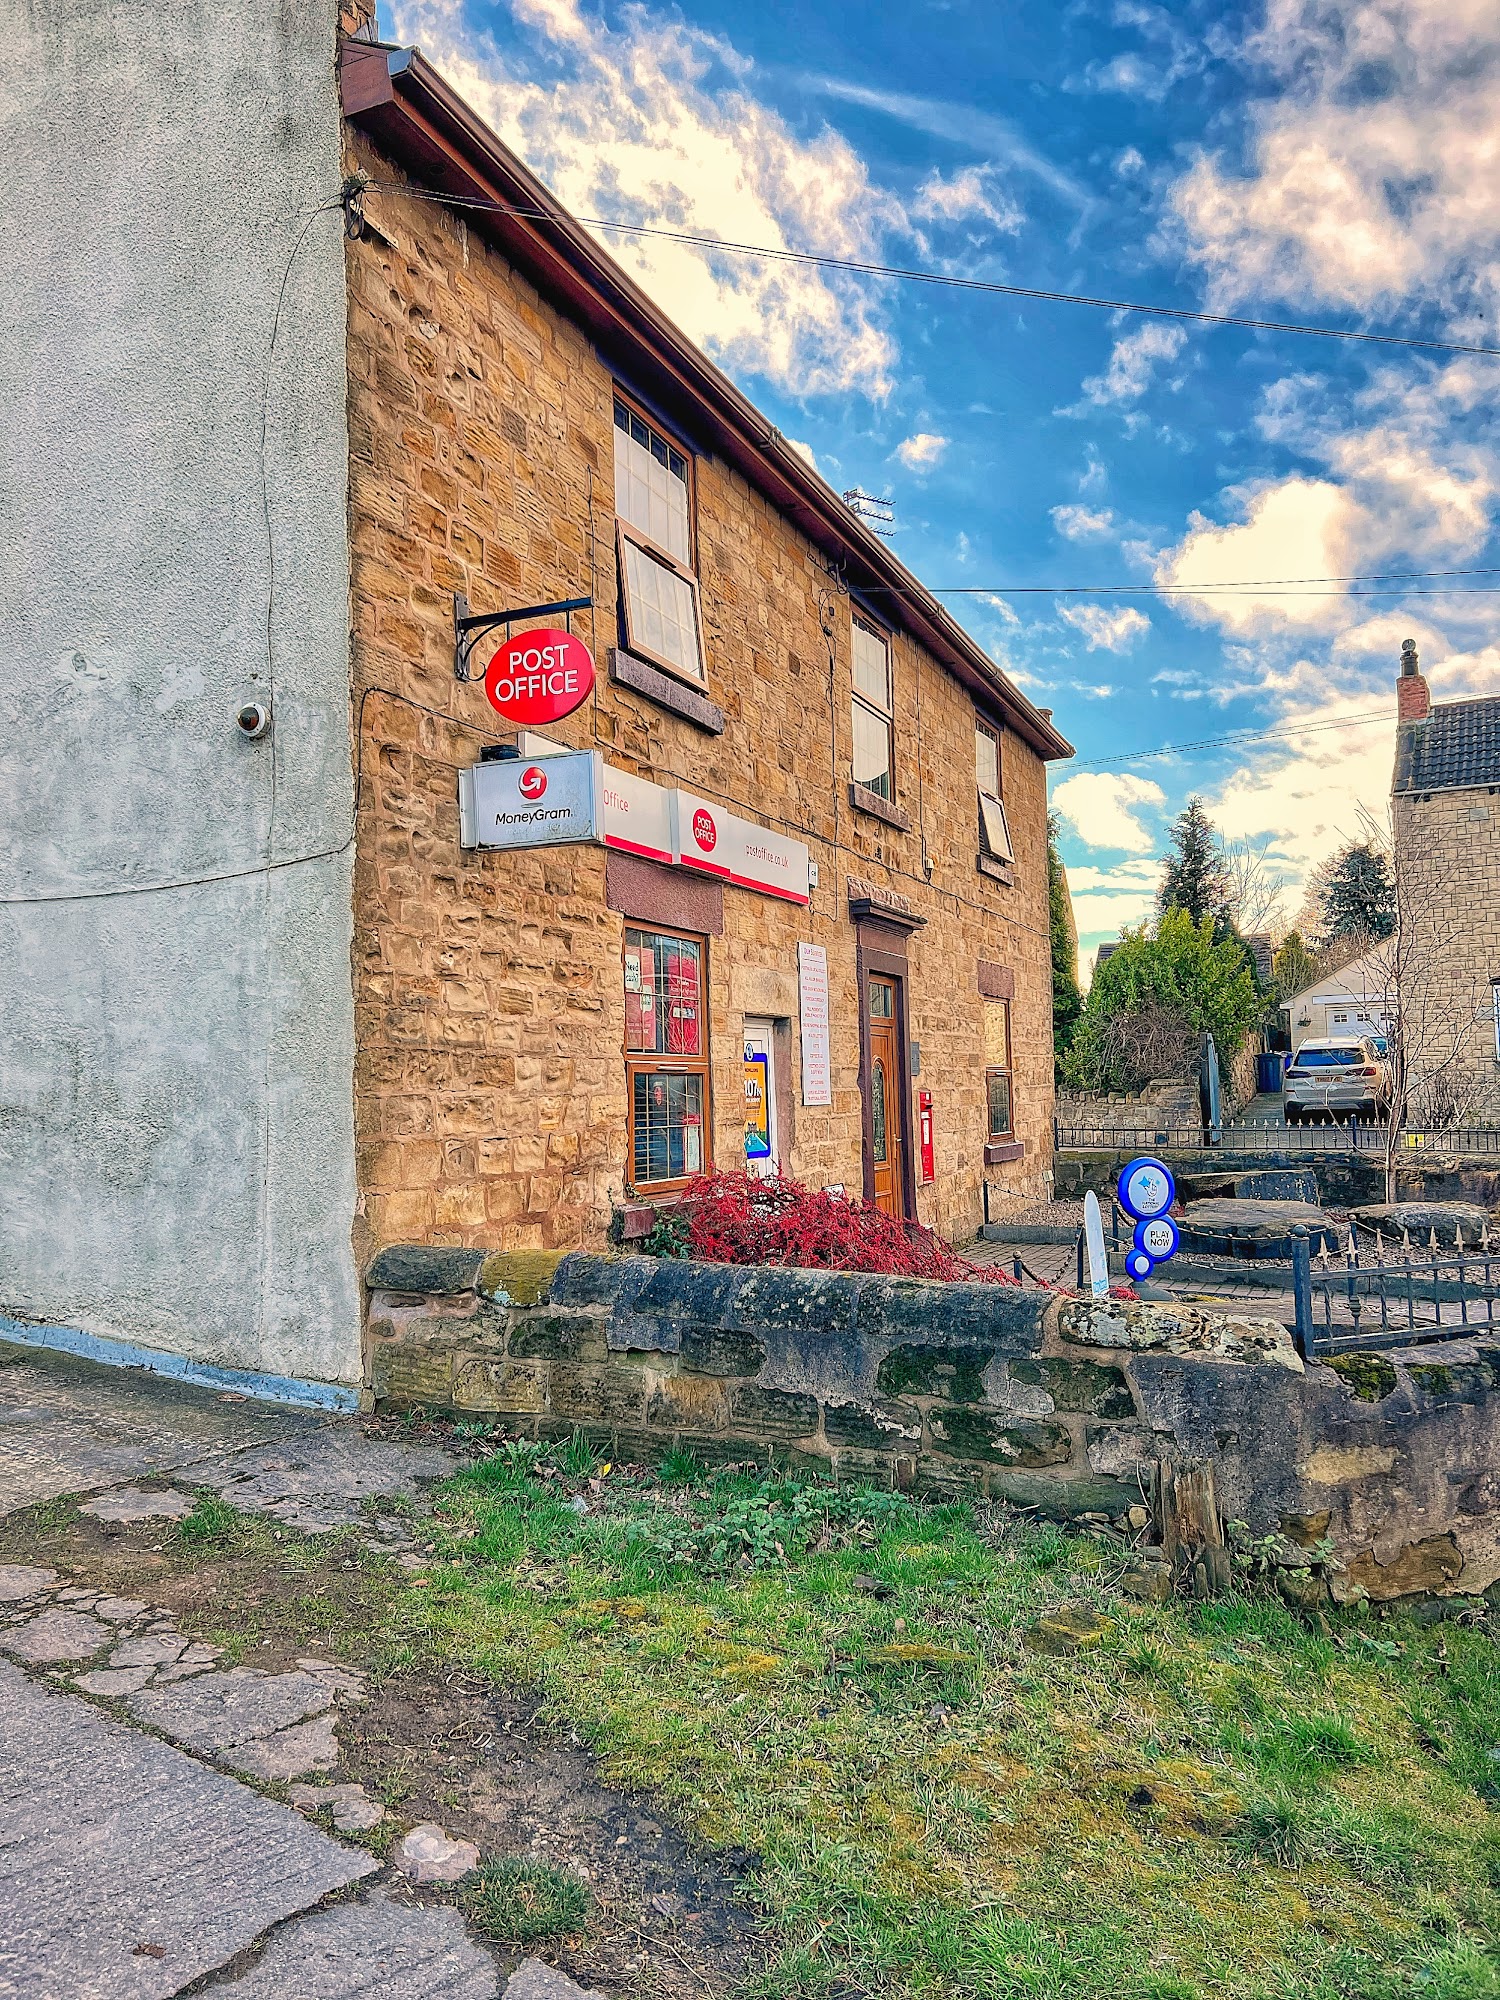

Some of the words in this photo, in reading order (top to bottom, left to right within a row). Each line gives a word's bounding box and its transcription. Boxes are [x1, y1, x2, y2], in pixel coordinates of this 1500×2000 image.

[509, 643, 570, 675] POST
[494, 669, 579, 702] OFFICE
[603, 788, 630, 813] Office
[697, 816, 712, 831] POST
[695, 828, 715, 844] OFFICE
[745, 844, 789, 869] postoffice.co.uk
[1150, 1230, 1170, 1238] PLAY
[1150, 1239, 1170, 1247] NOW
